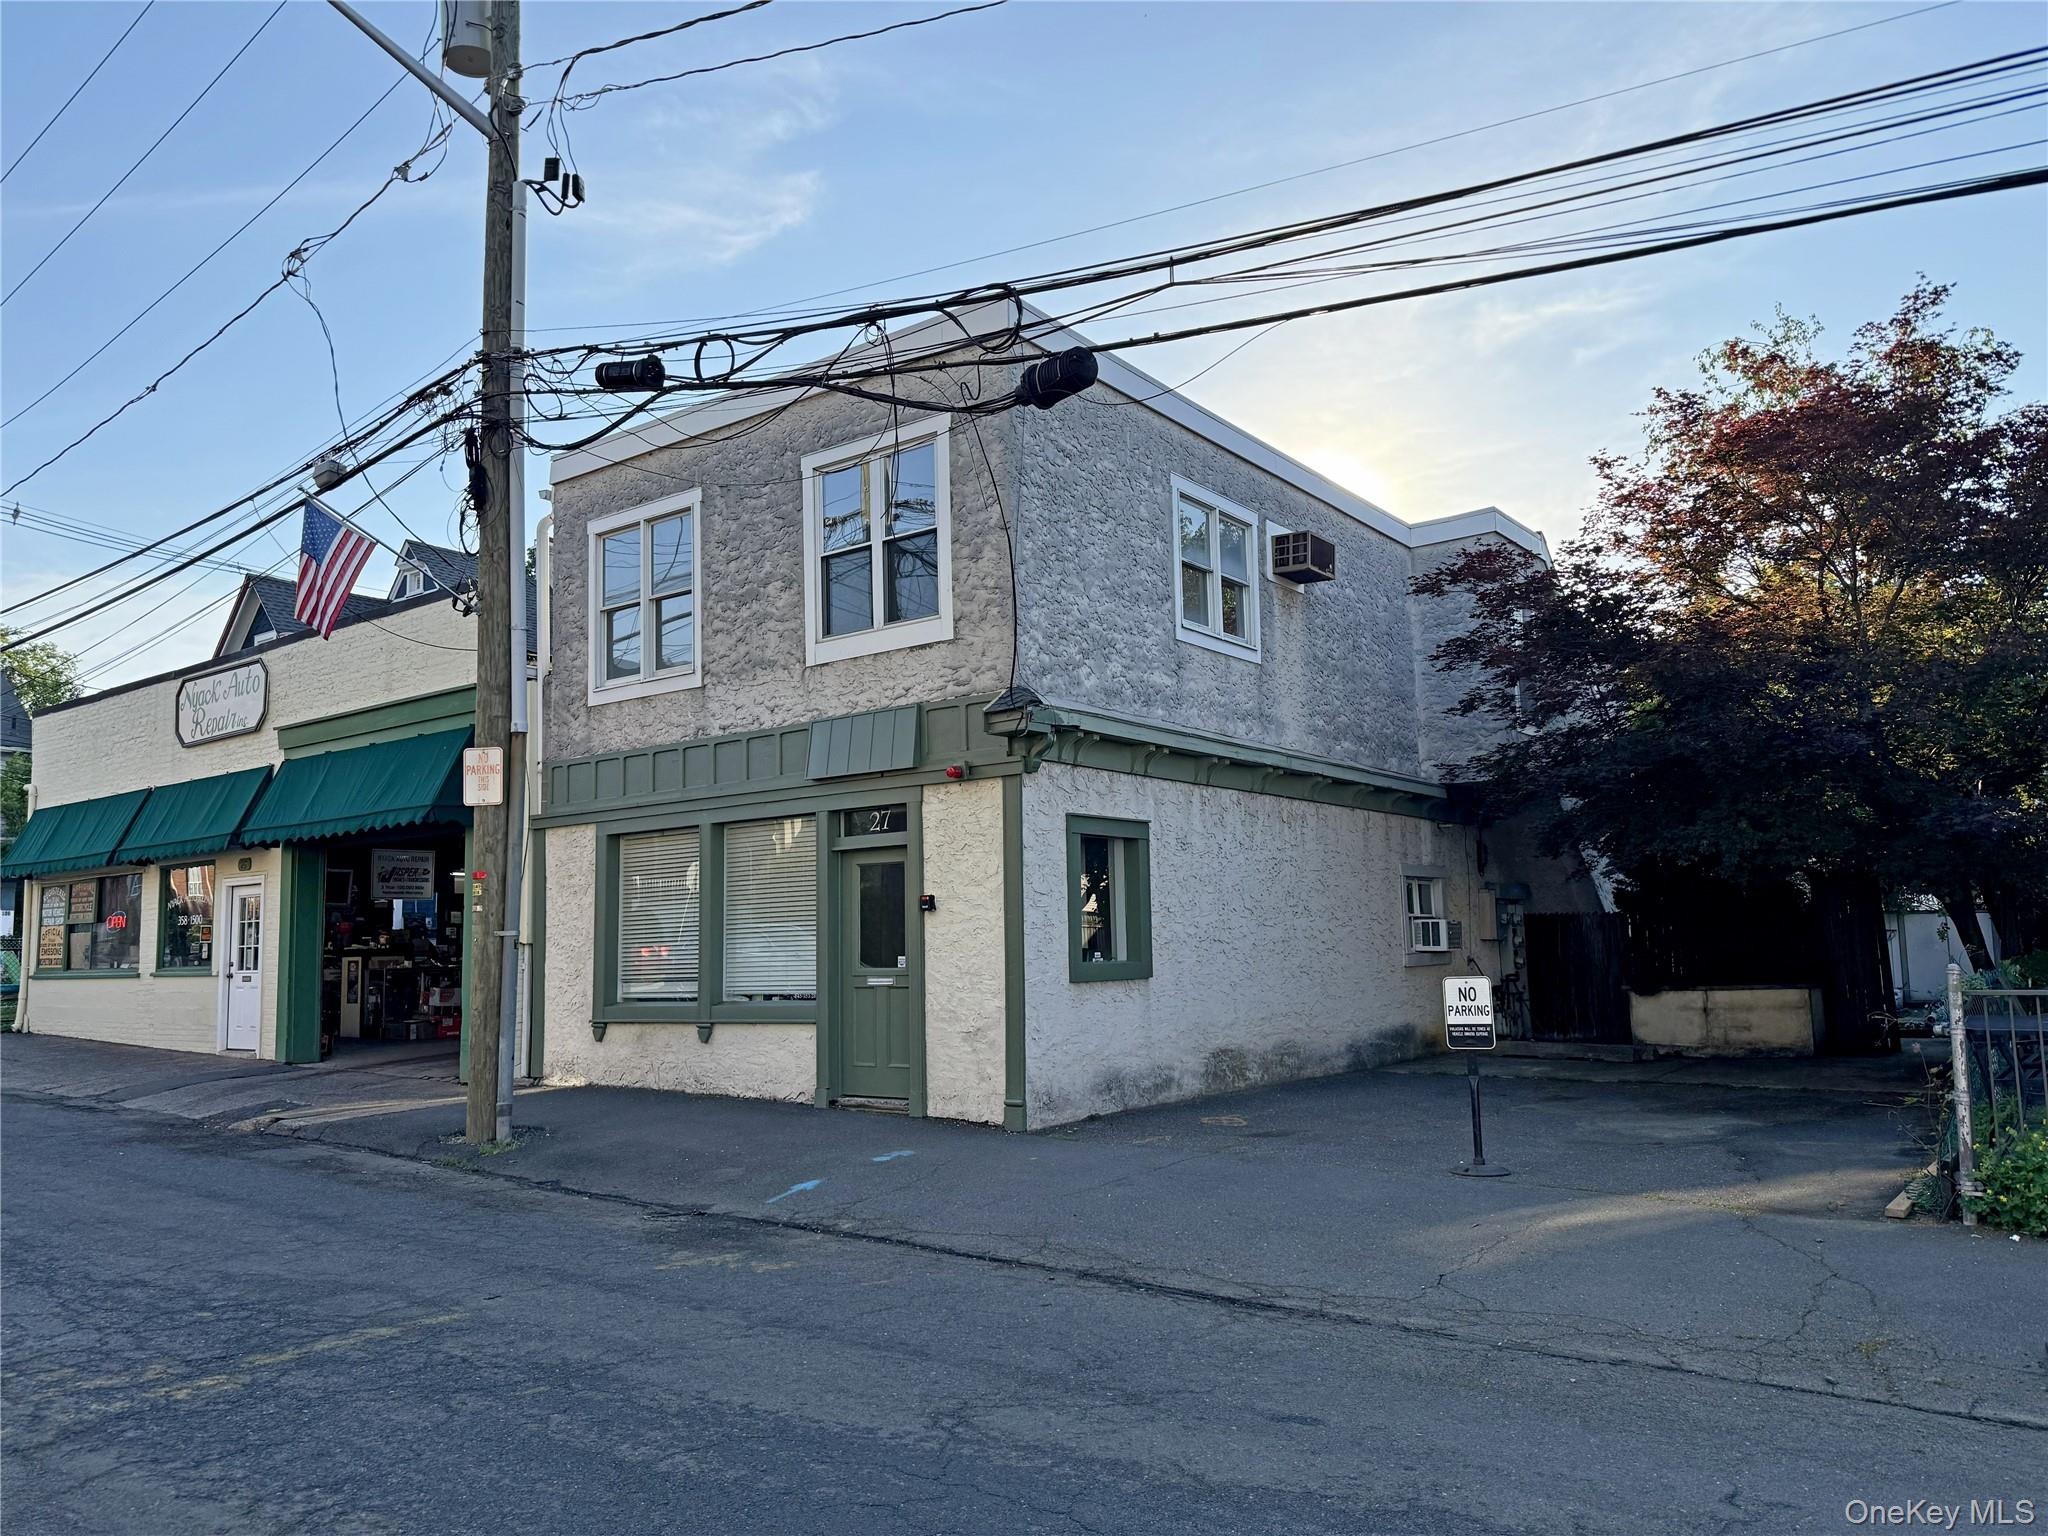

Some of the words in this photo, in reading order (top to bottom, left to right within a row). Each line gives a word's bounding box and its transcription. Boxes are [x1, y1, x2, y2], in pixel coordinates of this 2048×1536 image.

[181, 680, 221, 711] Nyack
[223, 669, 260, 699] Auto
[191, 707, 237, 738] Repair
[478, 752, 489, 763] NO
[466, 764, 501, 775] PARKING
[869, 810, 891, 832] 27
[106, 915, 126, 929] OPEN
[41, 928, 63, 941] OFFICIAL
[1458, 986, 1477, 1002] NO
[1447, 1004, 1490, 1017] PARKING
